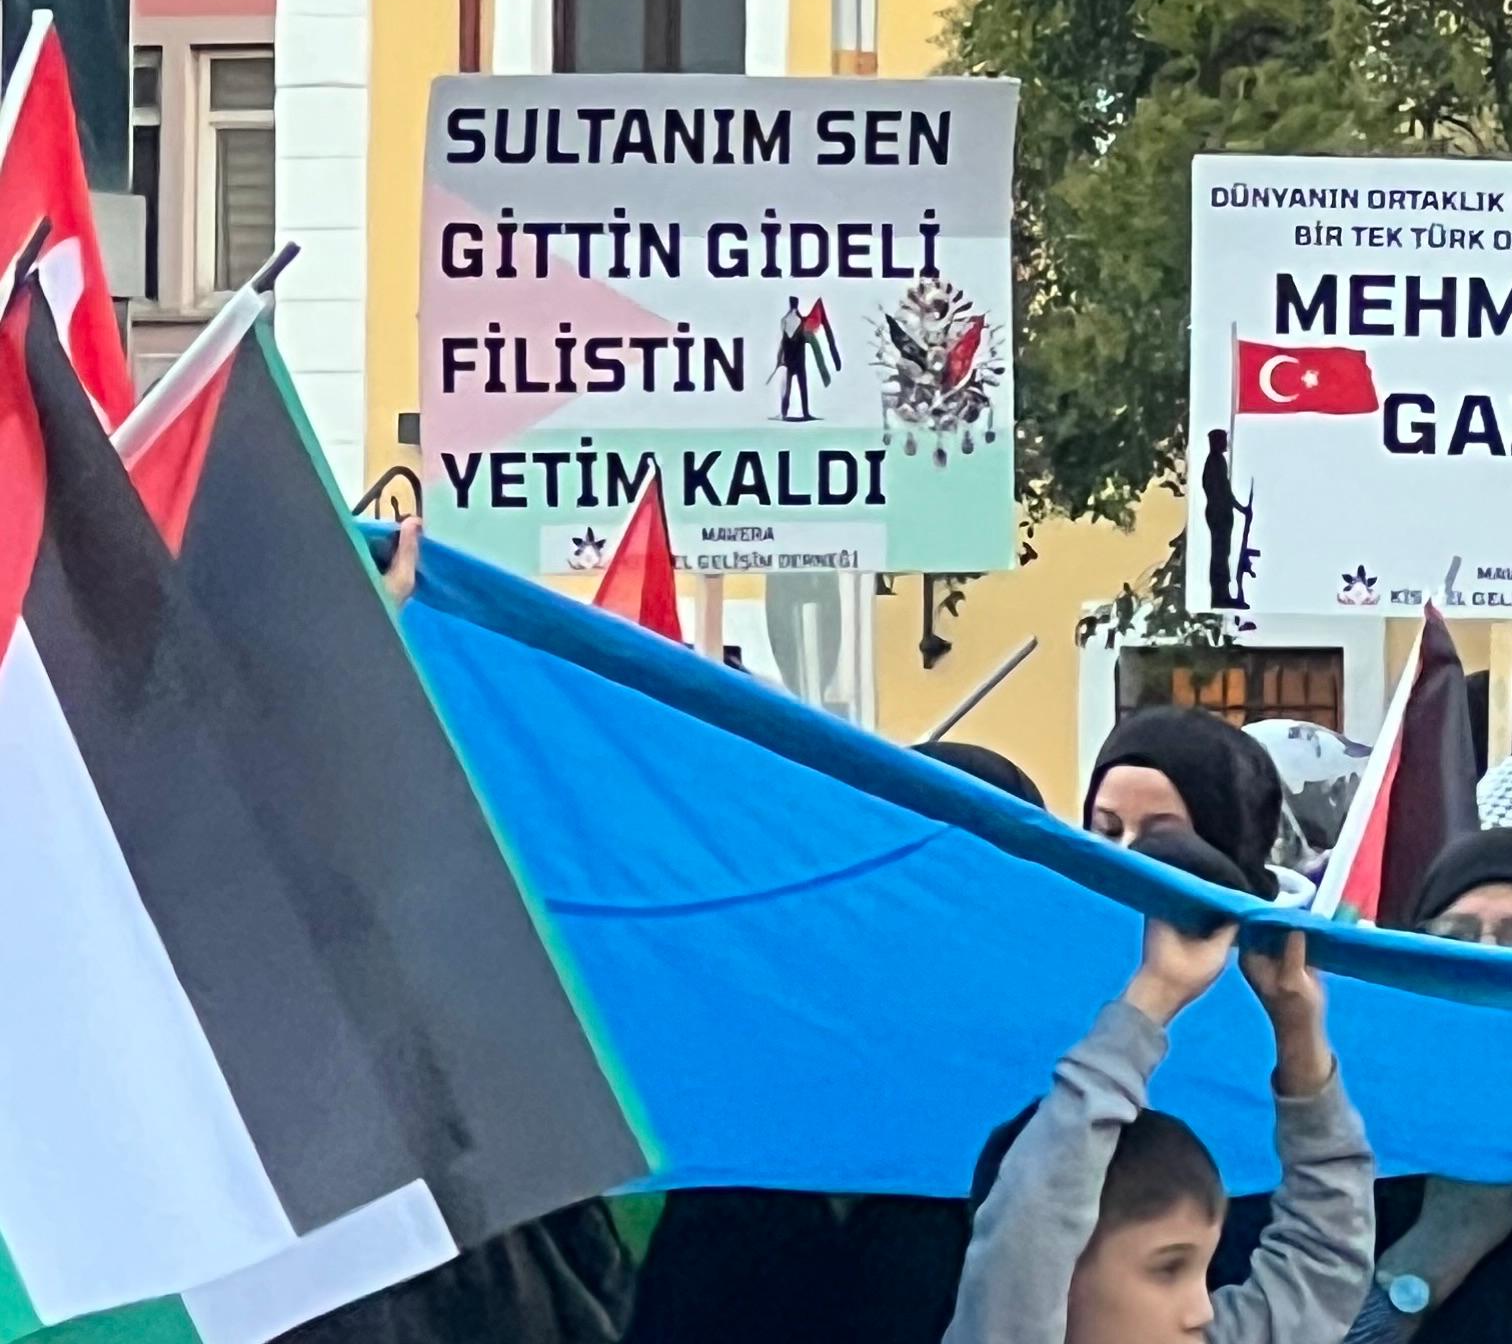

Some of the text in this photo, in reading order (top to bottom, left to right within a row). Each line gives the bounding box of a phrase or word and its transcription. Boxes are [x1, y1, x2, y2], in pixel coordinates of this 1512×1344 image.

[446, 108, 952, 166] SULTANIM SEN
[1211, 183, 1359, 209] DÜNYANIN
[1368, 190, 1505, 213] ORTAKLIK
[441, 208, 941, 279] GİTTİN GİDELİ
[1295, 220, 1343, 247] BİR
[1351, 226, 1403, 248] TEK
[1410, 223, 1485, 250] TÜRK
[442, 322, 745, 394] FİLİSTİN
[441, 437, 887, 509] YETİM KALDI
